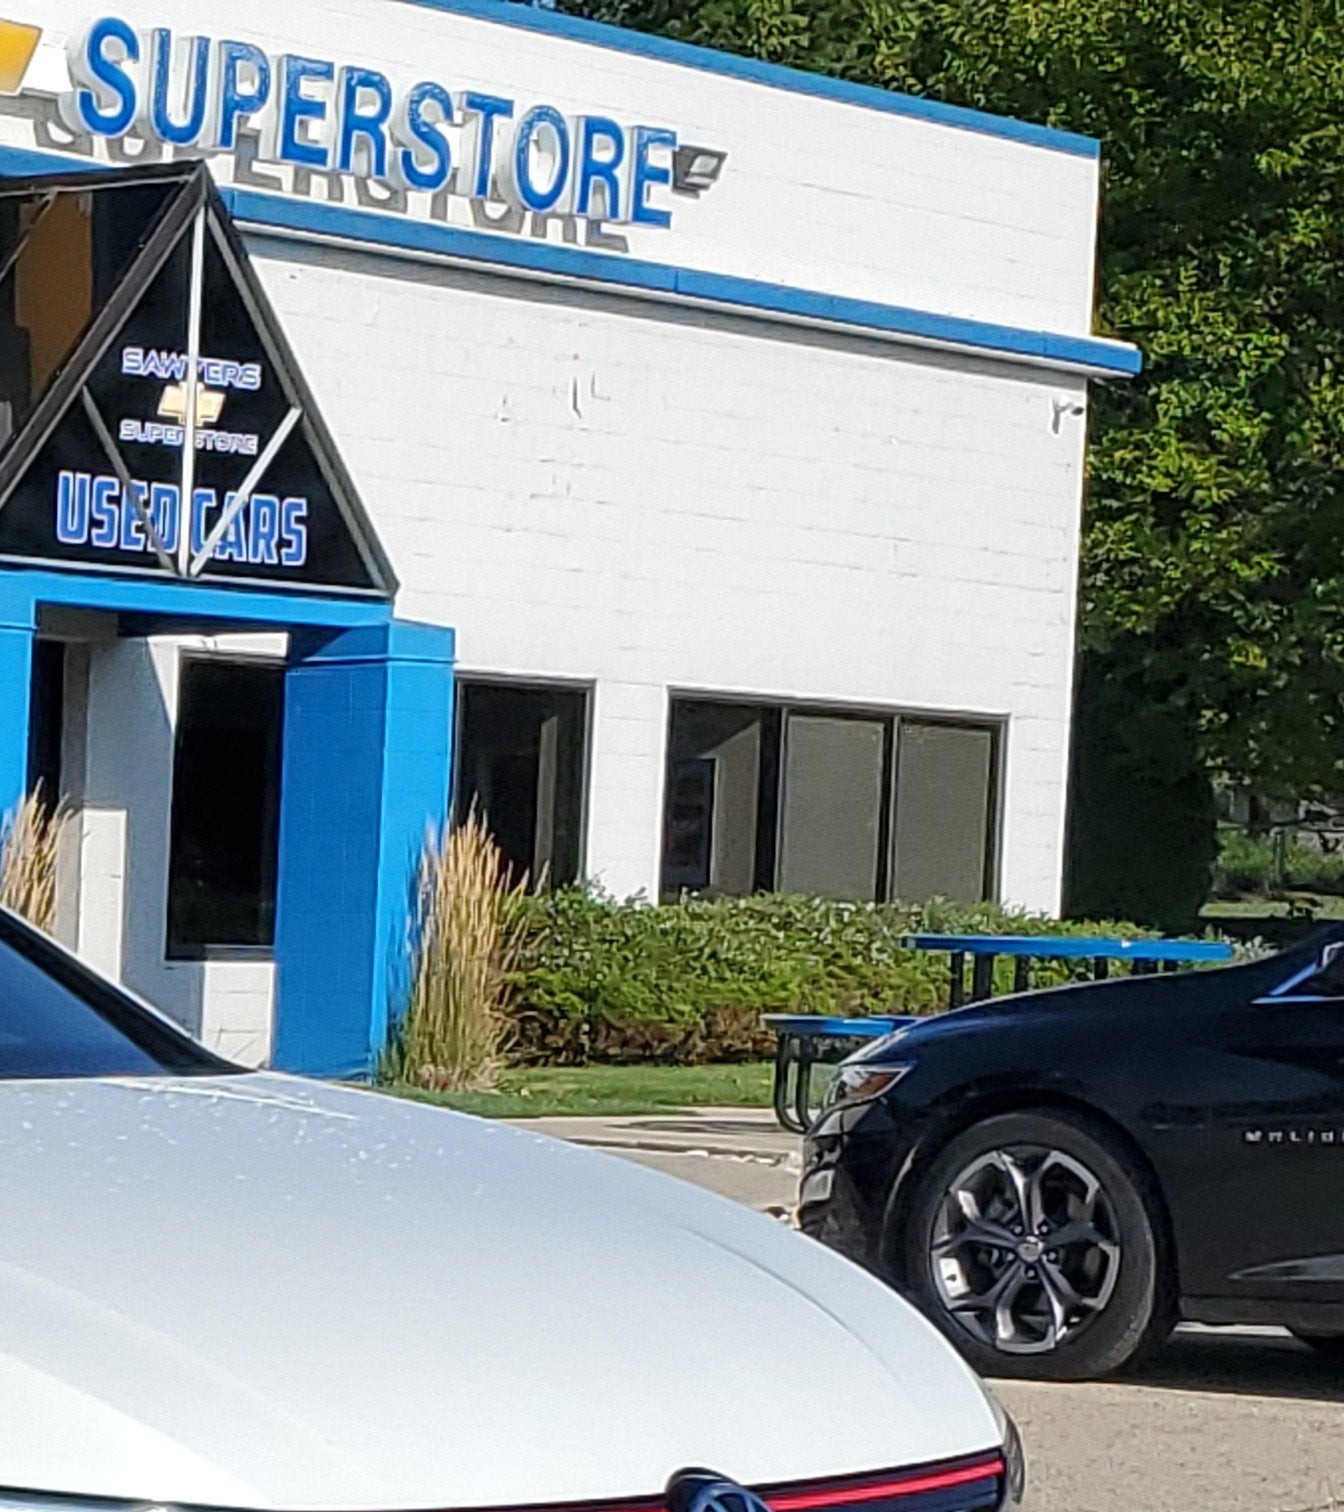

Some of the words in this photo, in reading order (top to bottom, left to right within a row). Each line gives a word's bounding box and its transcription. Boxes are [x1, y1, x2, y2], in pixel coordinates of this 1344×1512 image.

[75, 15, 677, 229] SUPERSTORE
[56, 470, 180, 554] USED
[191, 487, 308, 566] CARS
[1244, 1130, 1344, 1142] MALIB
